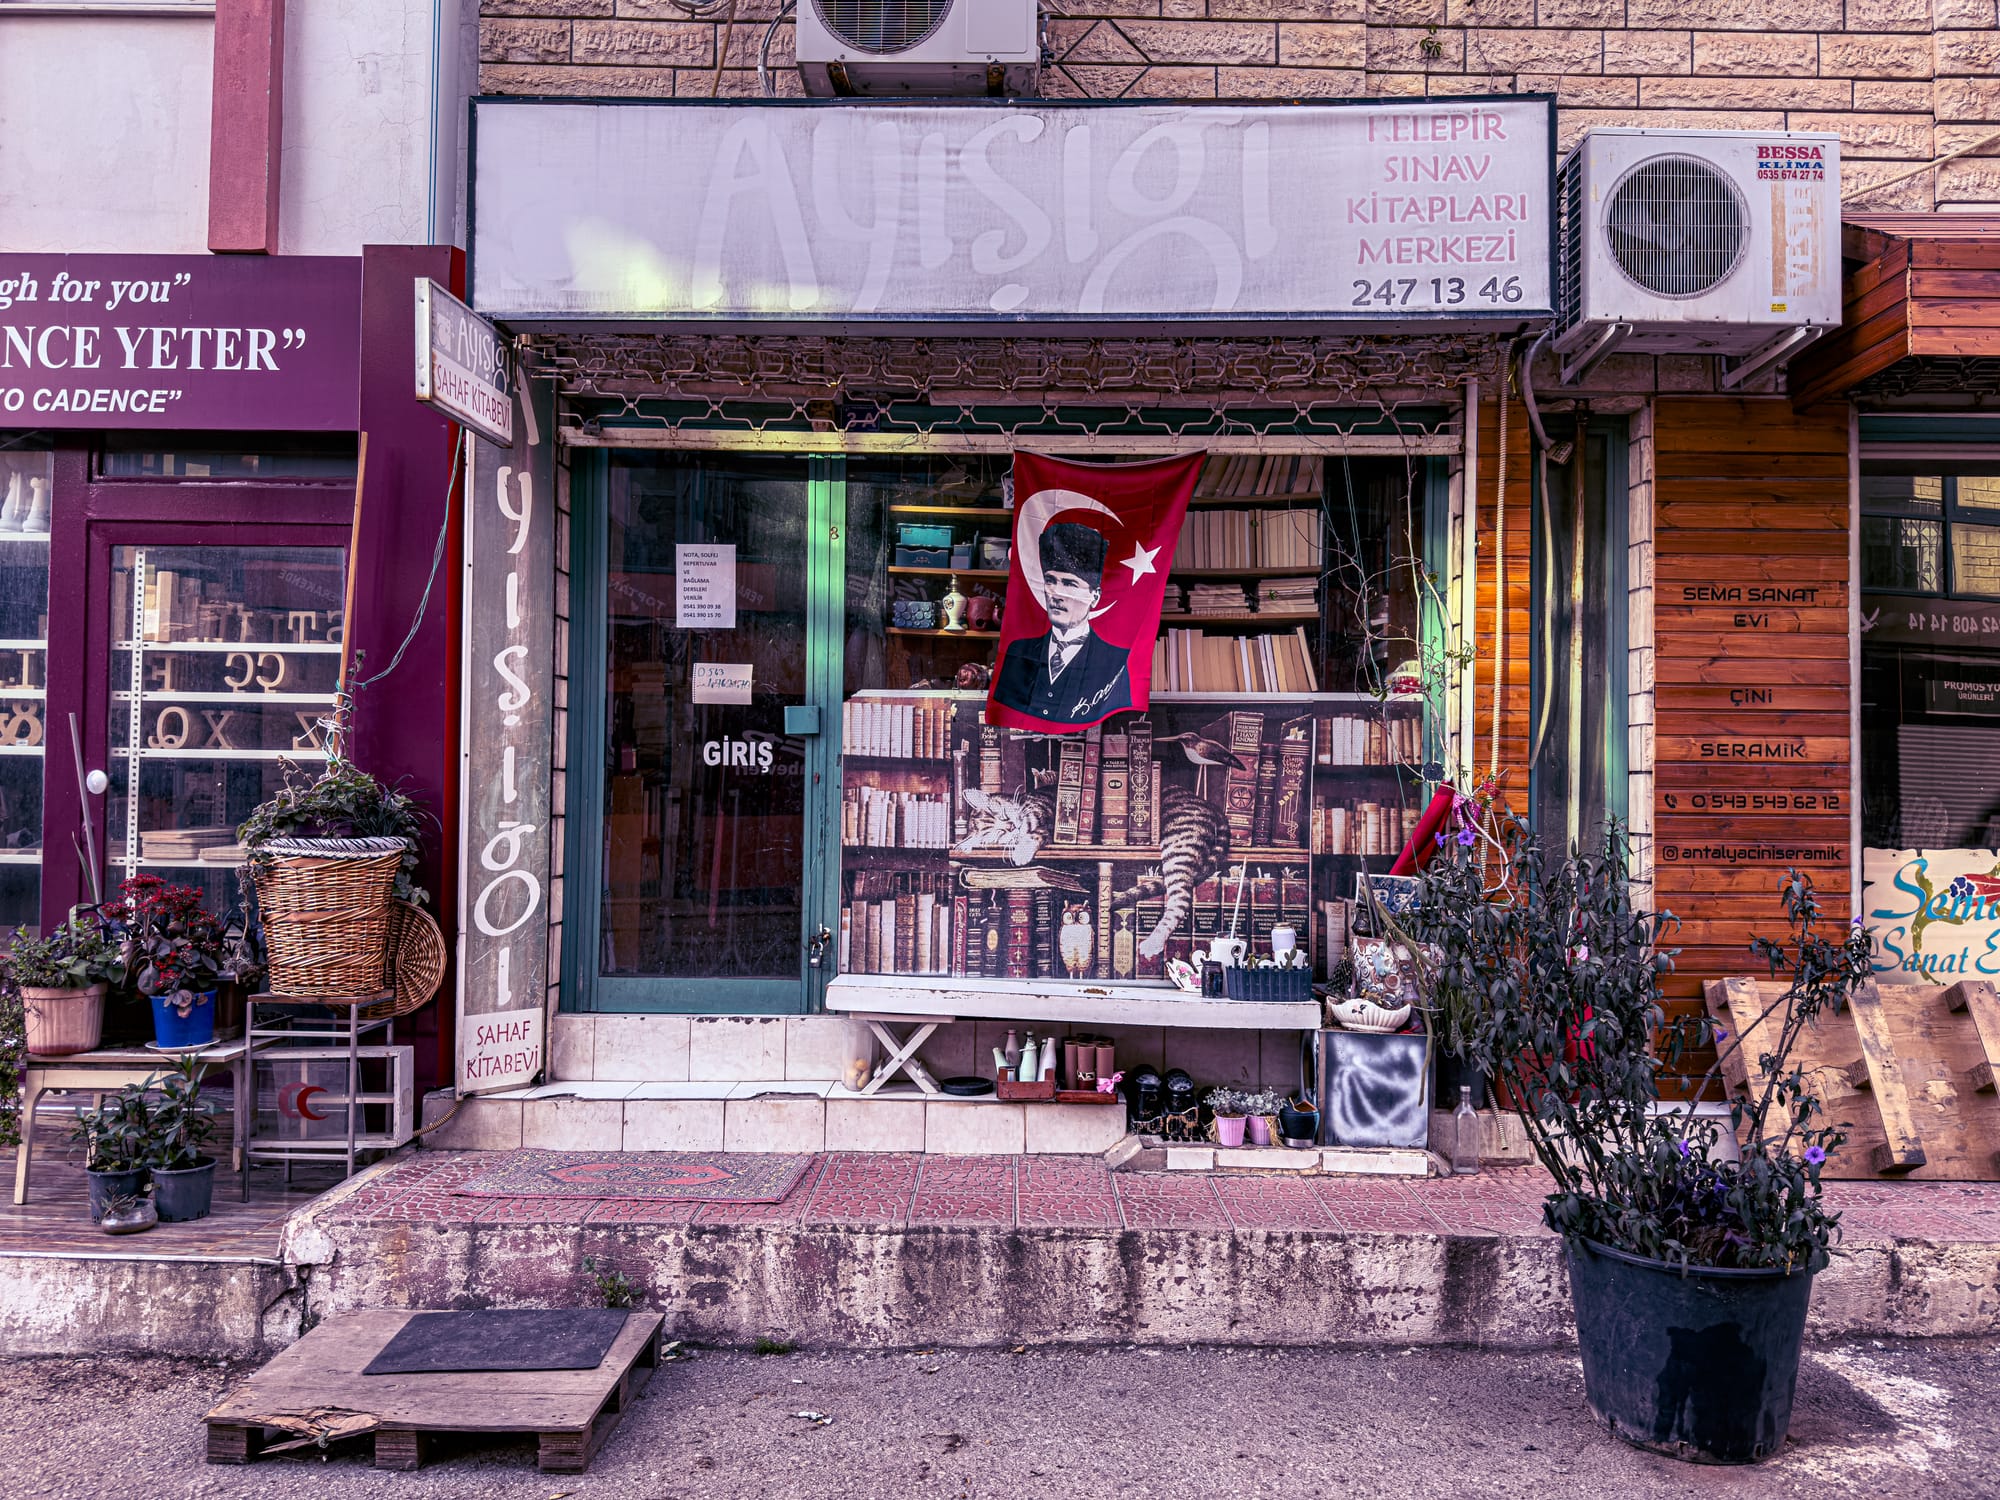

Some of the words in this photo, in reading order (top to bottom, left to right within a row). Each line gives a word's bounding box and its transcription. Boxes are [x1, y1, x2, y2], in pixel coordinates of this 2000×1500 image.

[1757, 146, 1823, 160] BESSA
[1758, 160, 1824, 169] KLİMA
[1384, 155, 1490, 182] SINAV
[1757, 170, 1779, 180] 0535
[1781, 170, 1798, 180] 674
[1799, 170, 1810, 180] 27
[1812, 170, 1823, 180] 74
[1347, 191, 1527, 224] KİTAPLARI
[1358, 229, 1516, 264] MERKEZİ
[48, 272, 100, 302] for
[1352, 278, 1417, 306] 247
[1430, 278, 1466, 304] 13
[1479, 276, 1523, 303] 46
[437, 365, 470, 406] SAHAF
[471, 384, 511, 432] KİTABEVİ
[1683, 587, 1741, 601] SEMA
[1748, 588, 1819, 602] SANAT
[1701, 743, 1804, 758] SERAMİK
[1692, 795, 1706, 809] 0
[1712, 795, 1746, 809] 543
[1753, 795, 1787, 809] 543
[1793, 795, 1816, 809] 62
[1822, 795, 1840, 809] 12
[1682, 845, 1841, 863] antalyaciniseramik
[1871, 926, 1969, 973] Sanat
[477, 1020, 531, 1046] SAHAF
[467, 1045, 539, 1078] KİTABEVİ
